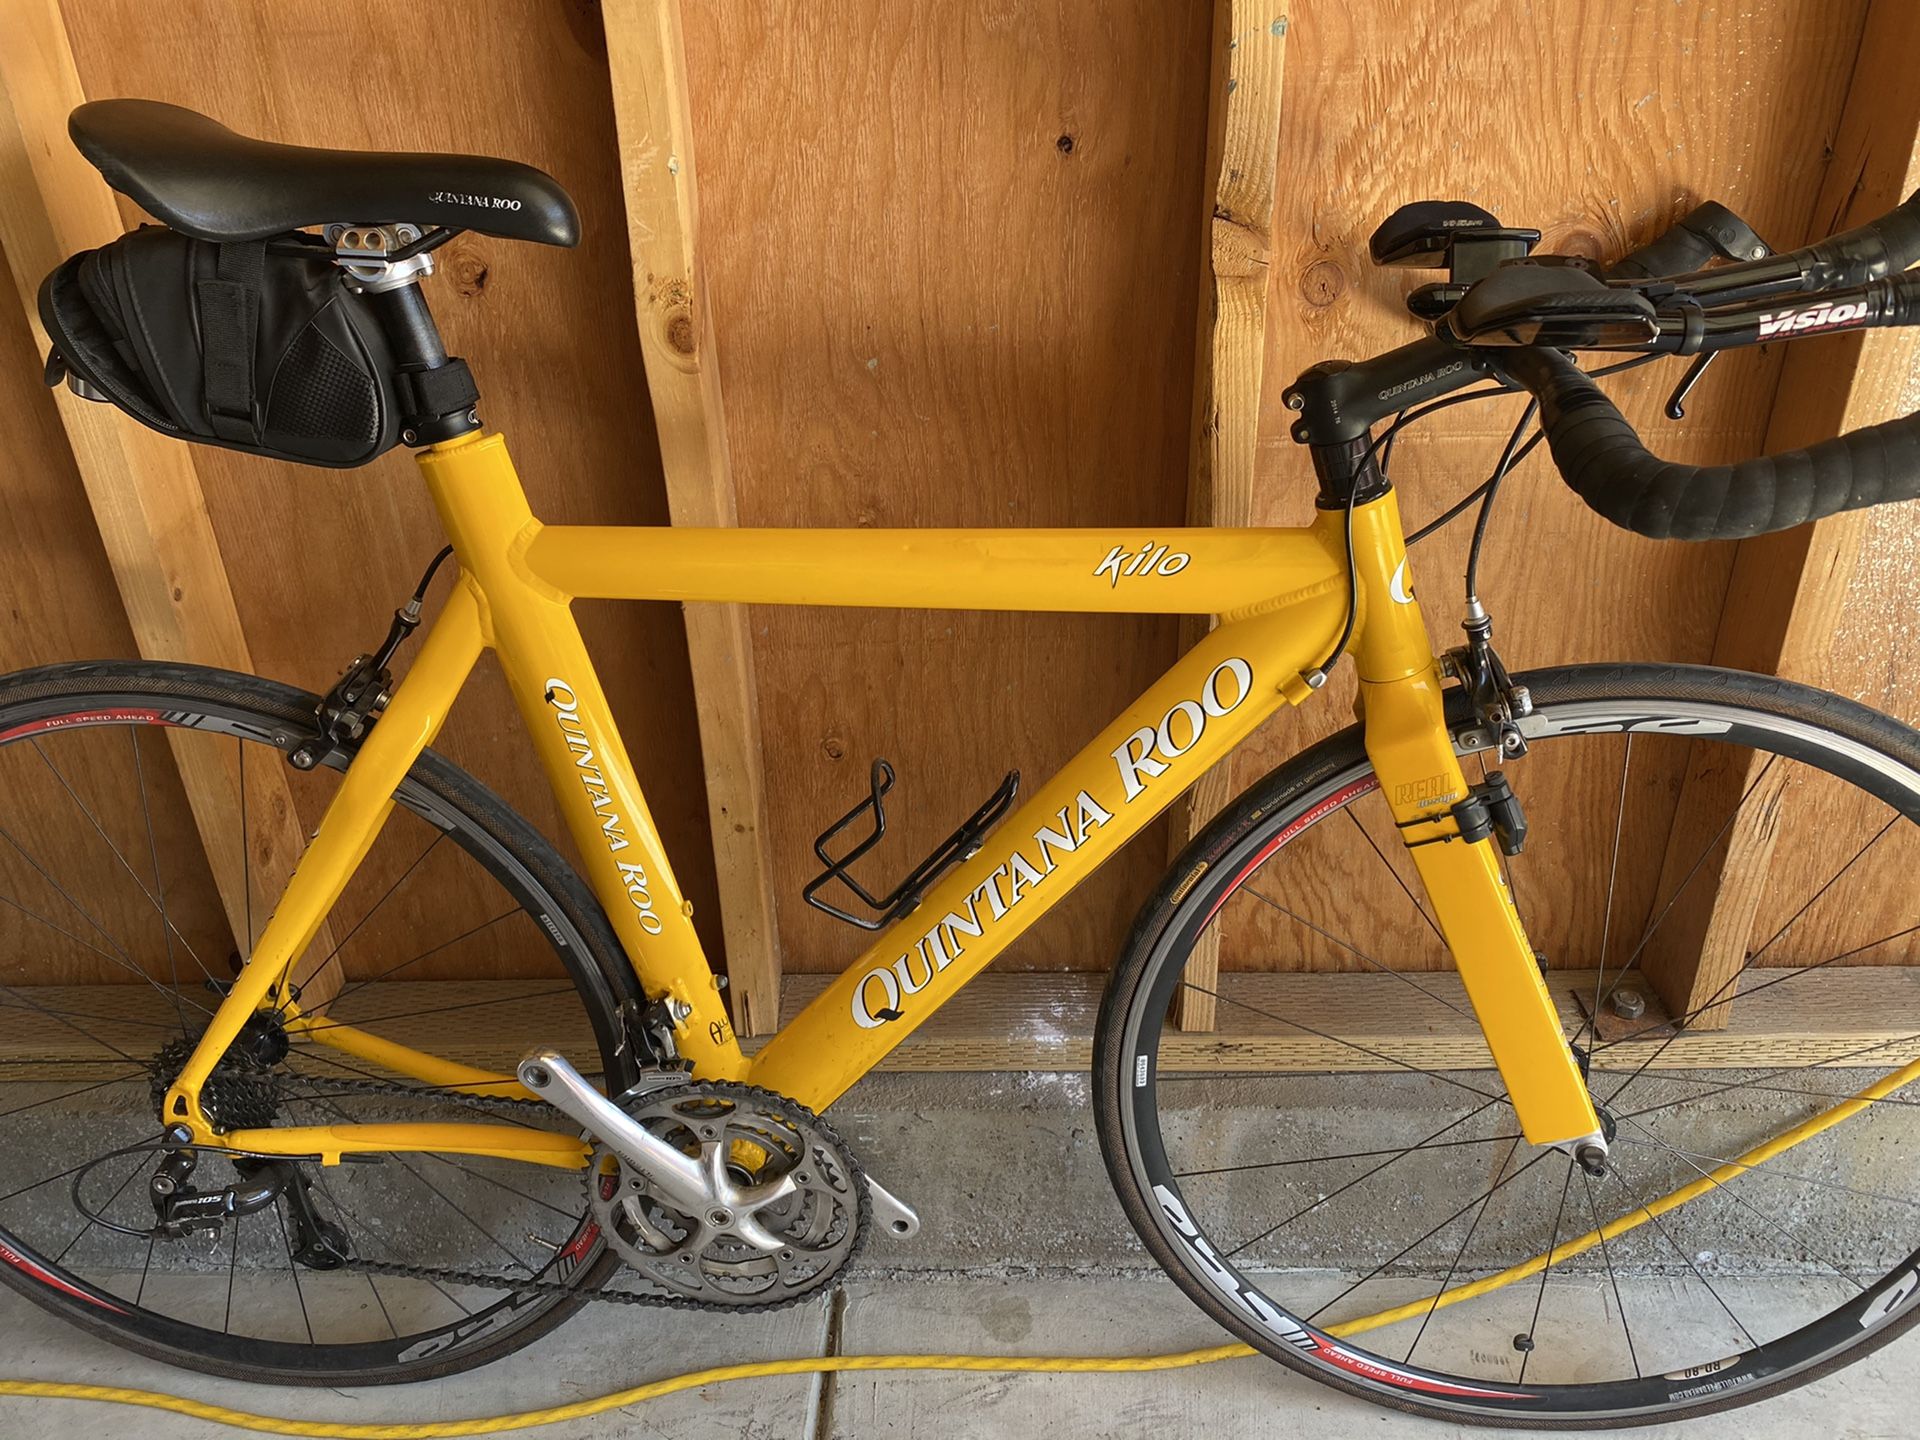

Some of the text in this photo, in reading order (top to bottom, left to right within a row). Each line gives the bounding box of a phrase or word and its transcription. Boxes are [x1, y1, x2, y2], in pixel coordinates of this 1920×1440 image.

[491, 197, 521, 211] ROO
[1378, 361, 1464, 400] QUINTANA ROO
[1092, 540, 1191, 589] kilo
[46, 713, 155, 728] FULL SPEED AHEAD
[545, 677, 630, 854] QUINTANA
[615, 859, 664, 936] ROO
[1394, 772, 1457, 807] REAL
[1277, 824, 1301, 843] FULL
[1303, 800, 1338, 824] SPEED
[1340, 778, 1380, 801] AHEAD
[850, 656, 1253, 1030] QUINTANA ROO
[198, 1194, 223, 1204] 105
[1321, 1347, 1414, 1386] FULL SPEED AHEAD
